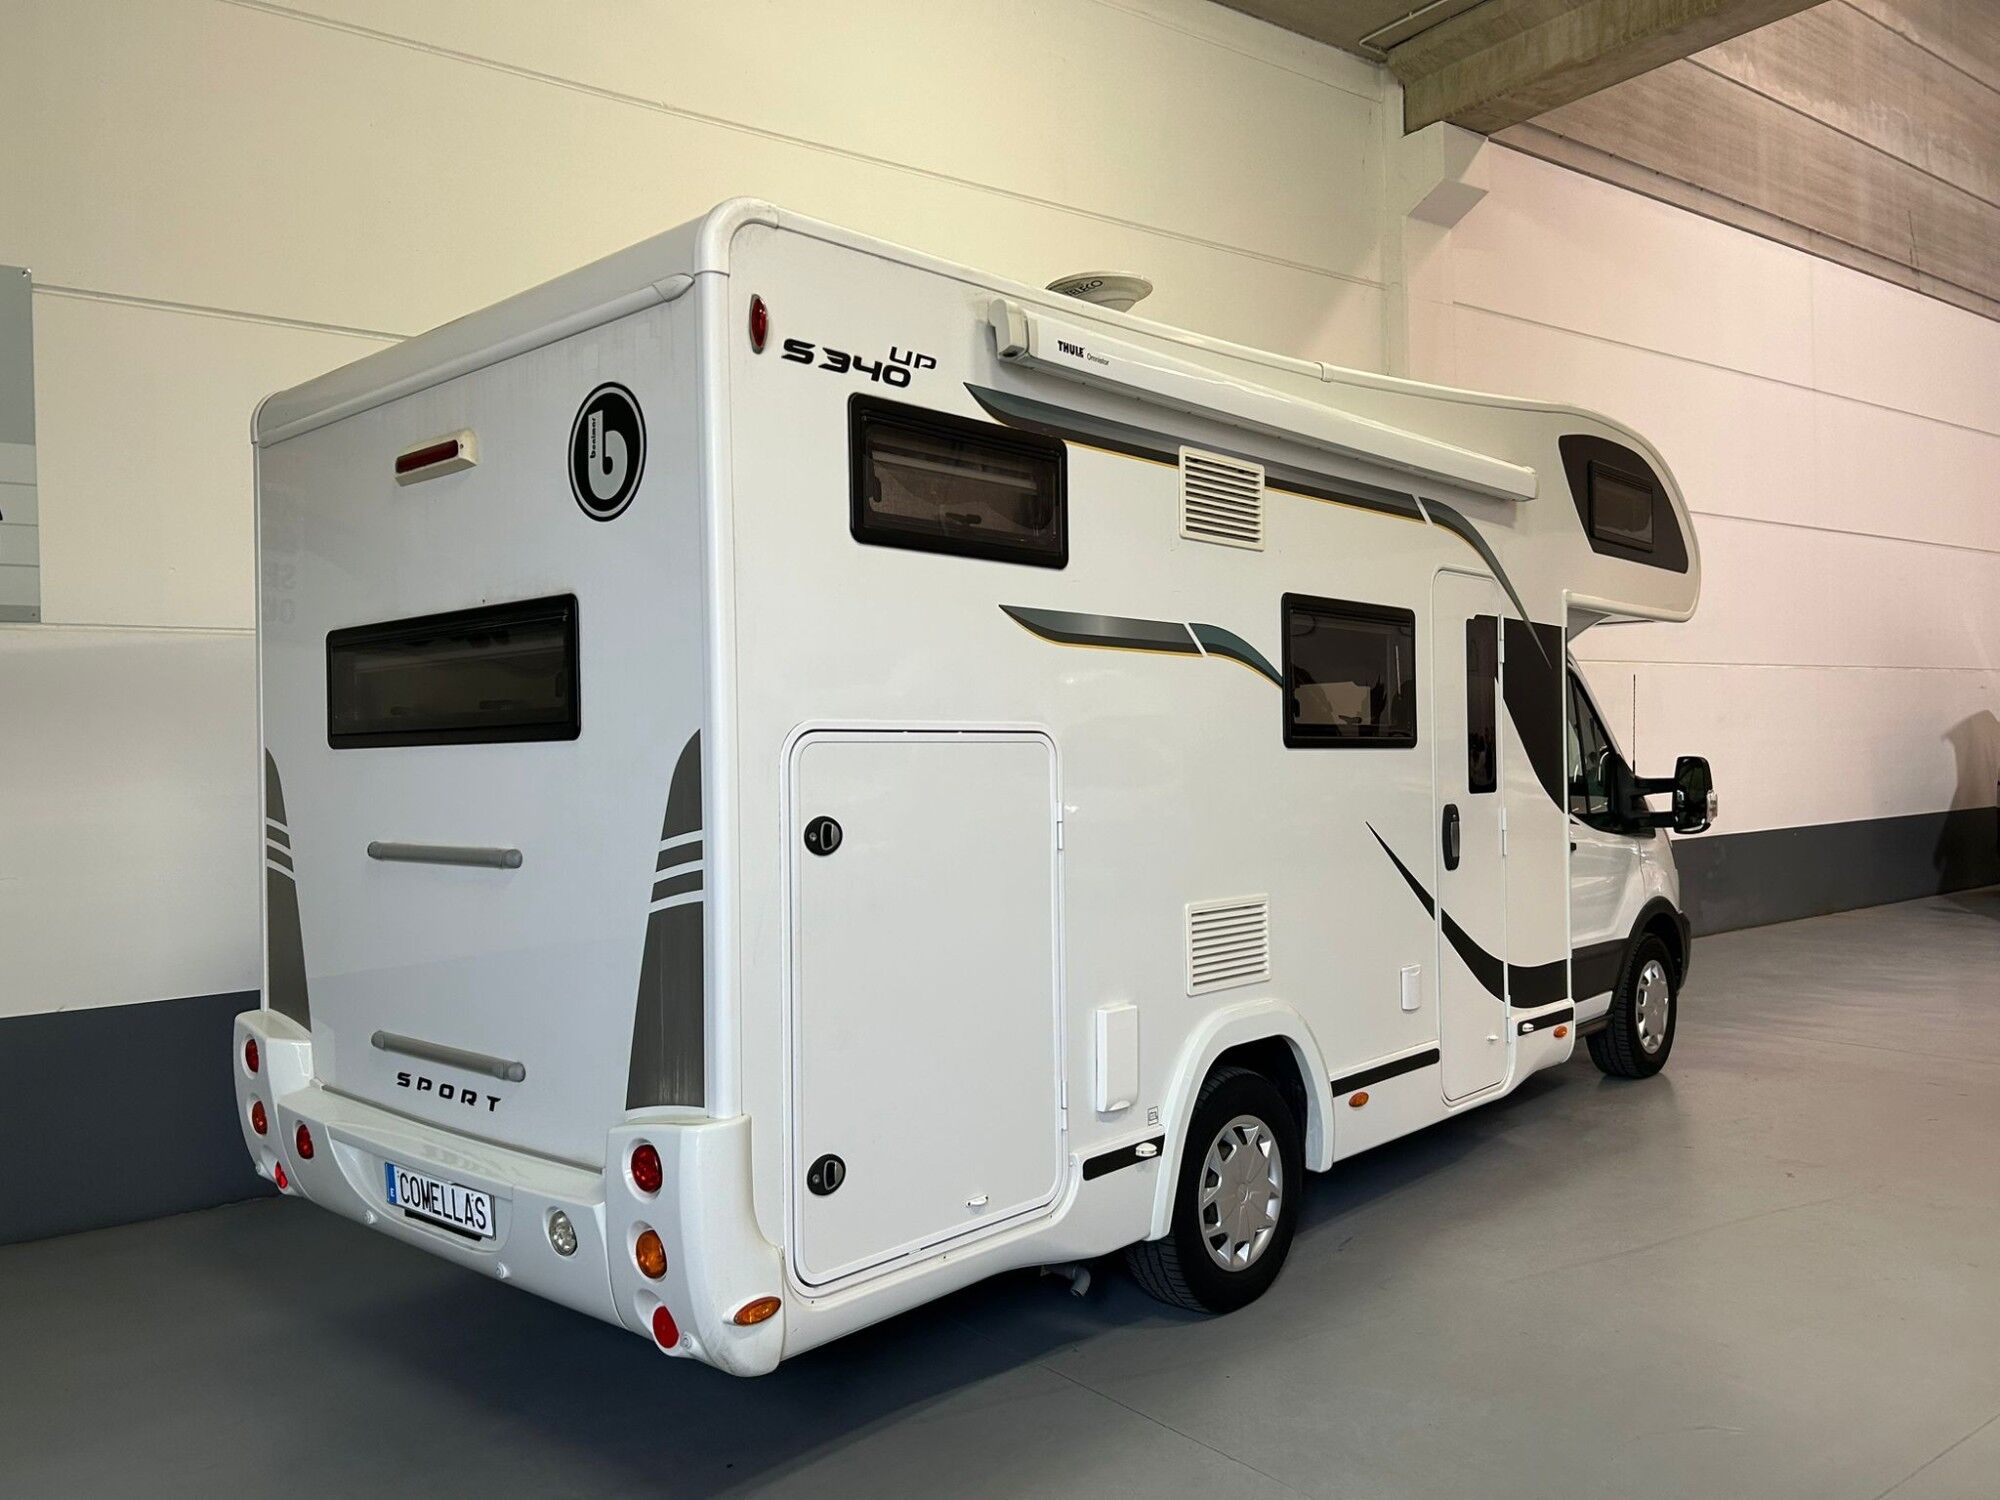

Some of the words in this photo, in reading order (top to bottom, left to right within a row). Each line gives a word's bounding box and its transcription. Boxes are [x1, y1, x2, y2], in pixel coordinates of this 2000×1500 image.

[889, 346, 937, 369] UP
[1057, 340, 1085, 358] THULE
[396, 1072, 501, 1112] SPORT
[400, 1172, 487, 1230] COMELLAS
